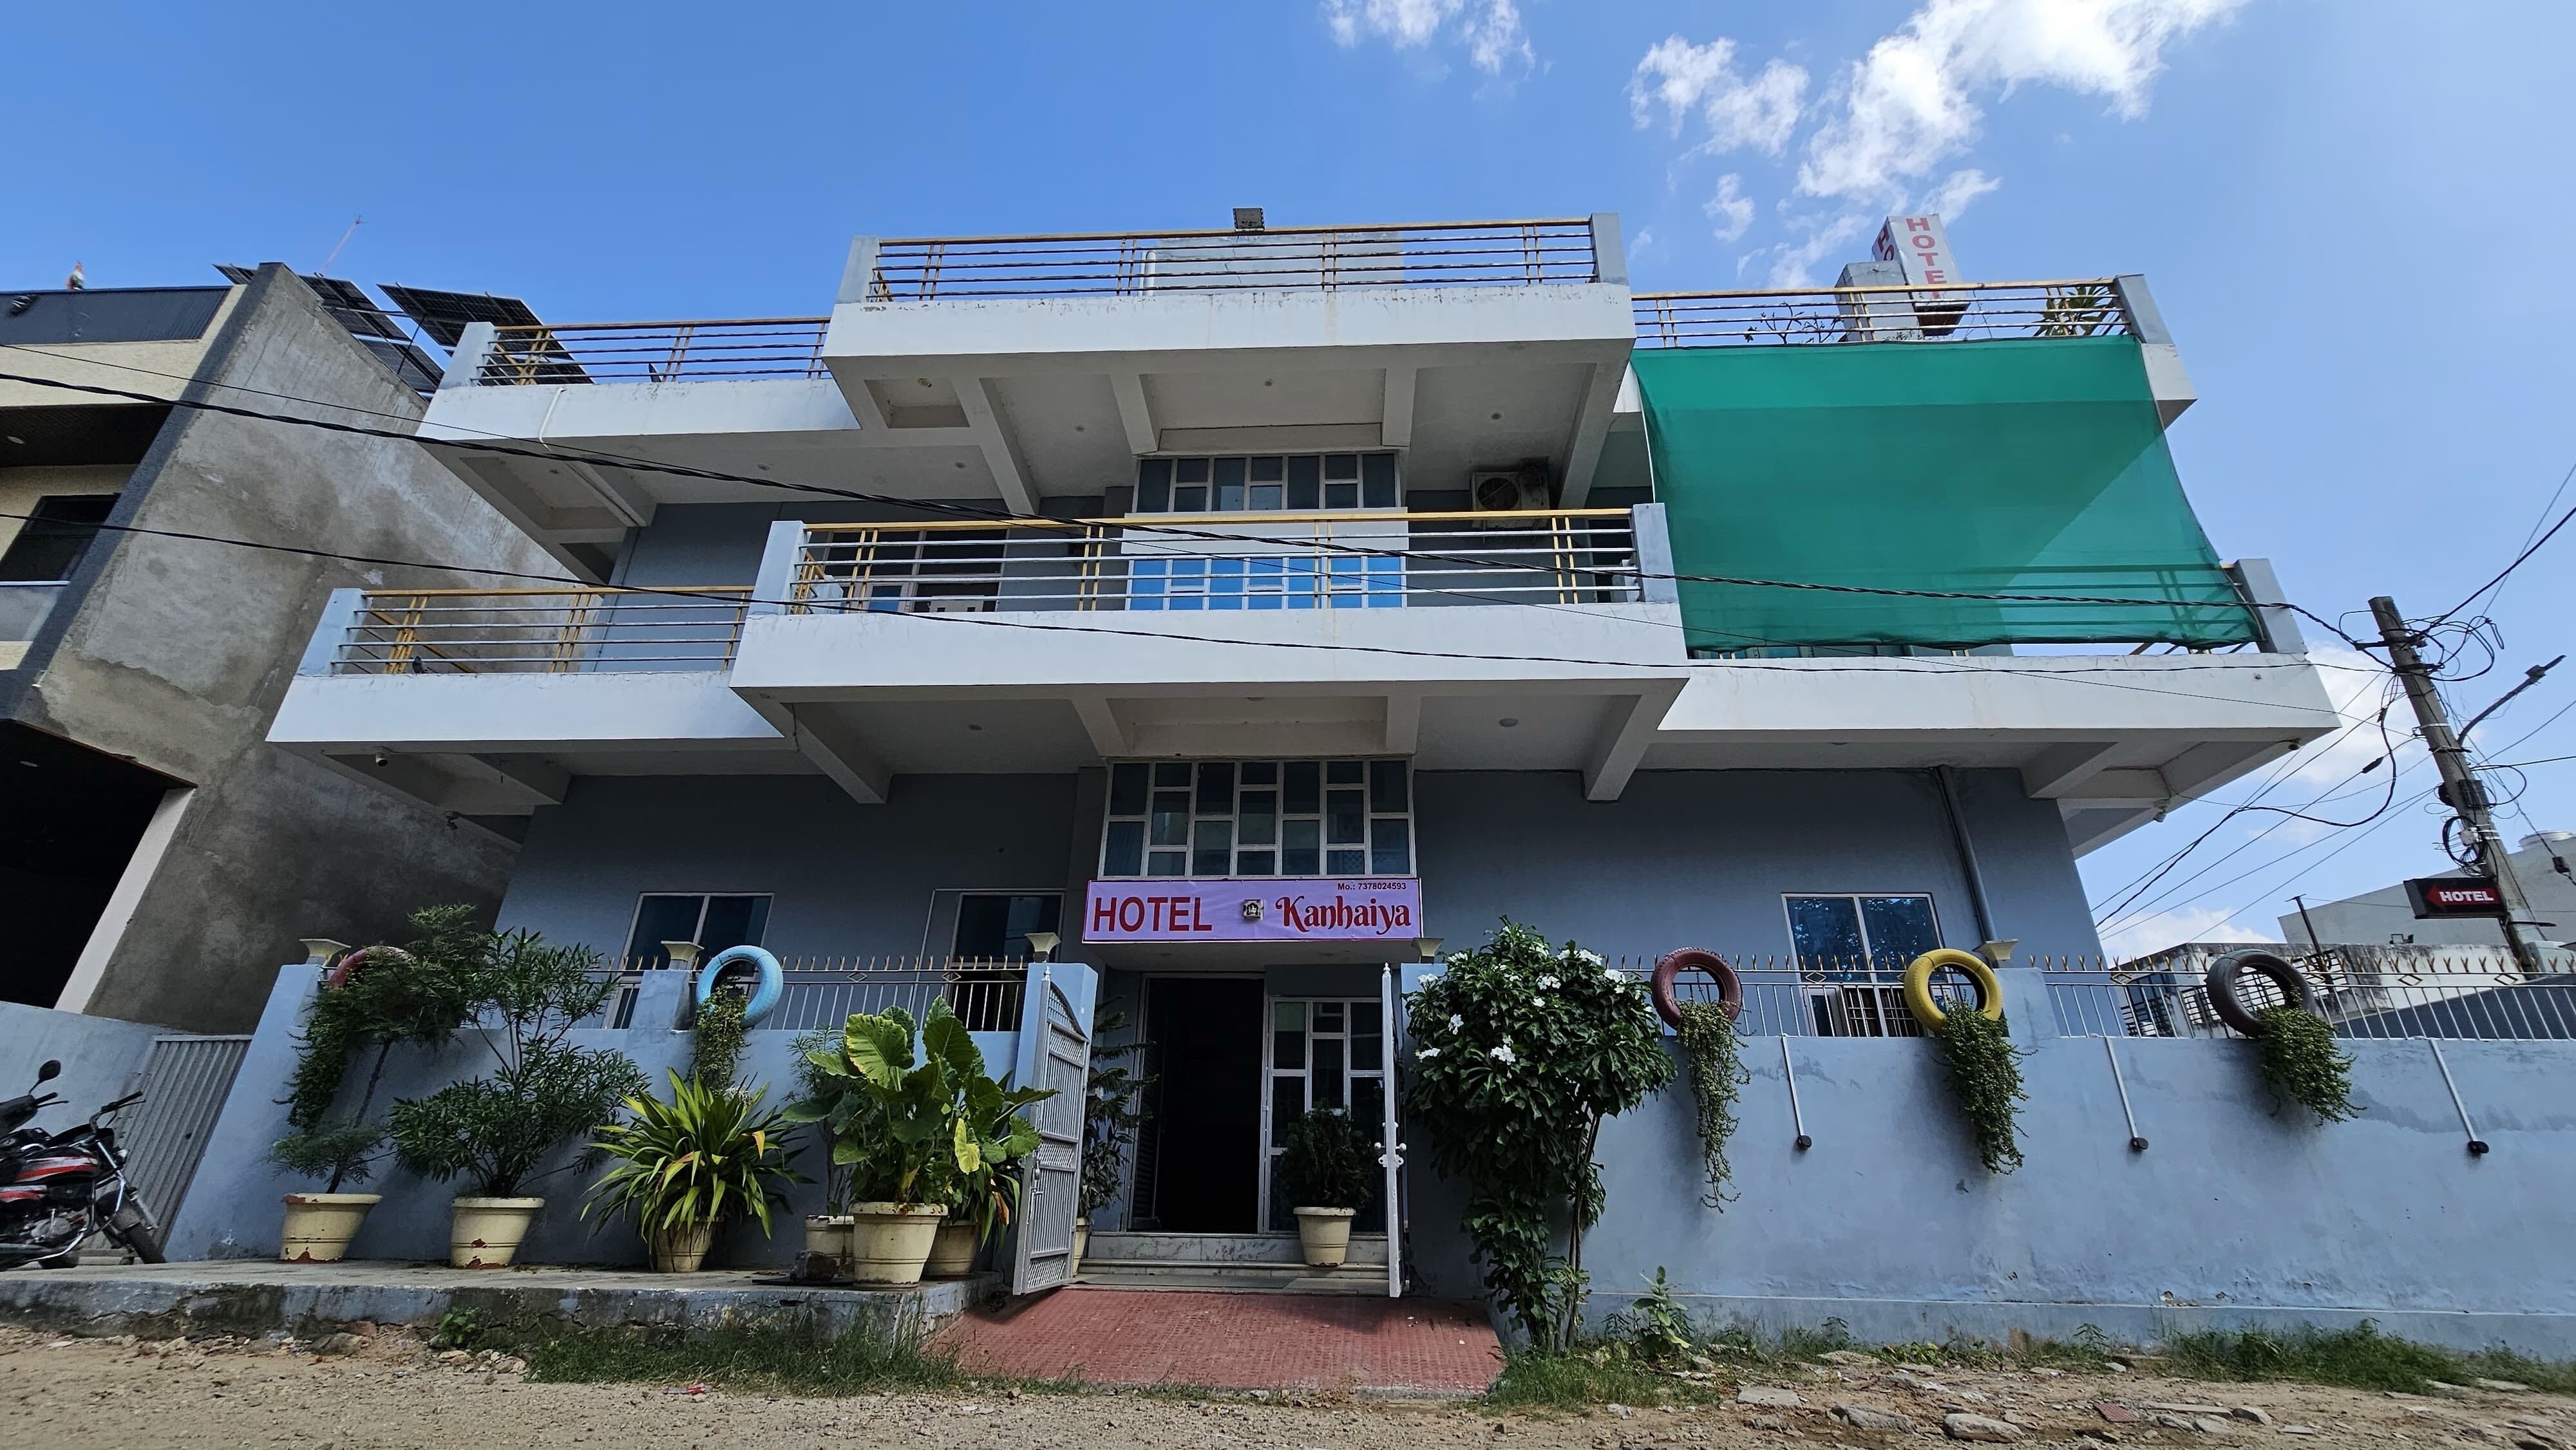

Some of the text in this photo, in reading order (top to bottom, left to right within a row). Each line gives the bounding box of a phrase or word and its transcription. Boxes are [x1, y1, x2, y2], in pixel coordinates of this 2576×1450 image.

[2438, 890, 2494, 902] HOTEL
[1093, 895, 1412, 935] HOTEL Kanhaiya
